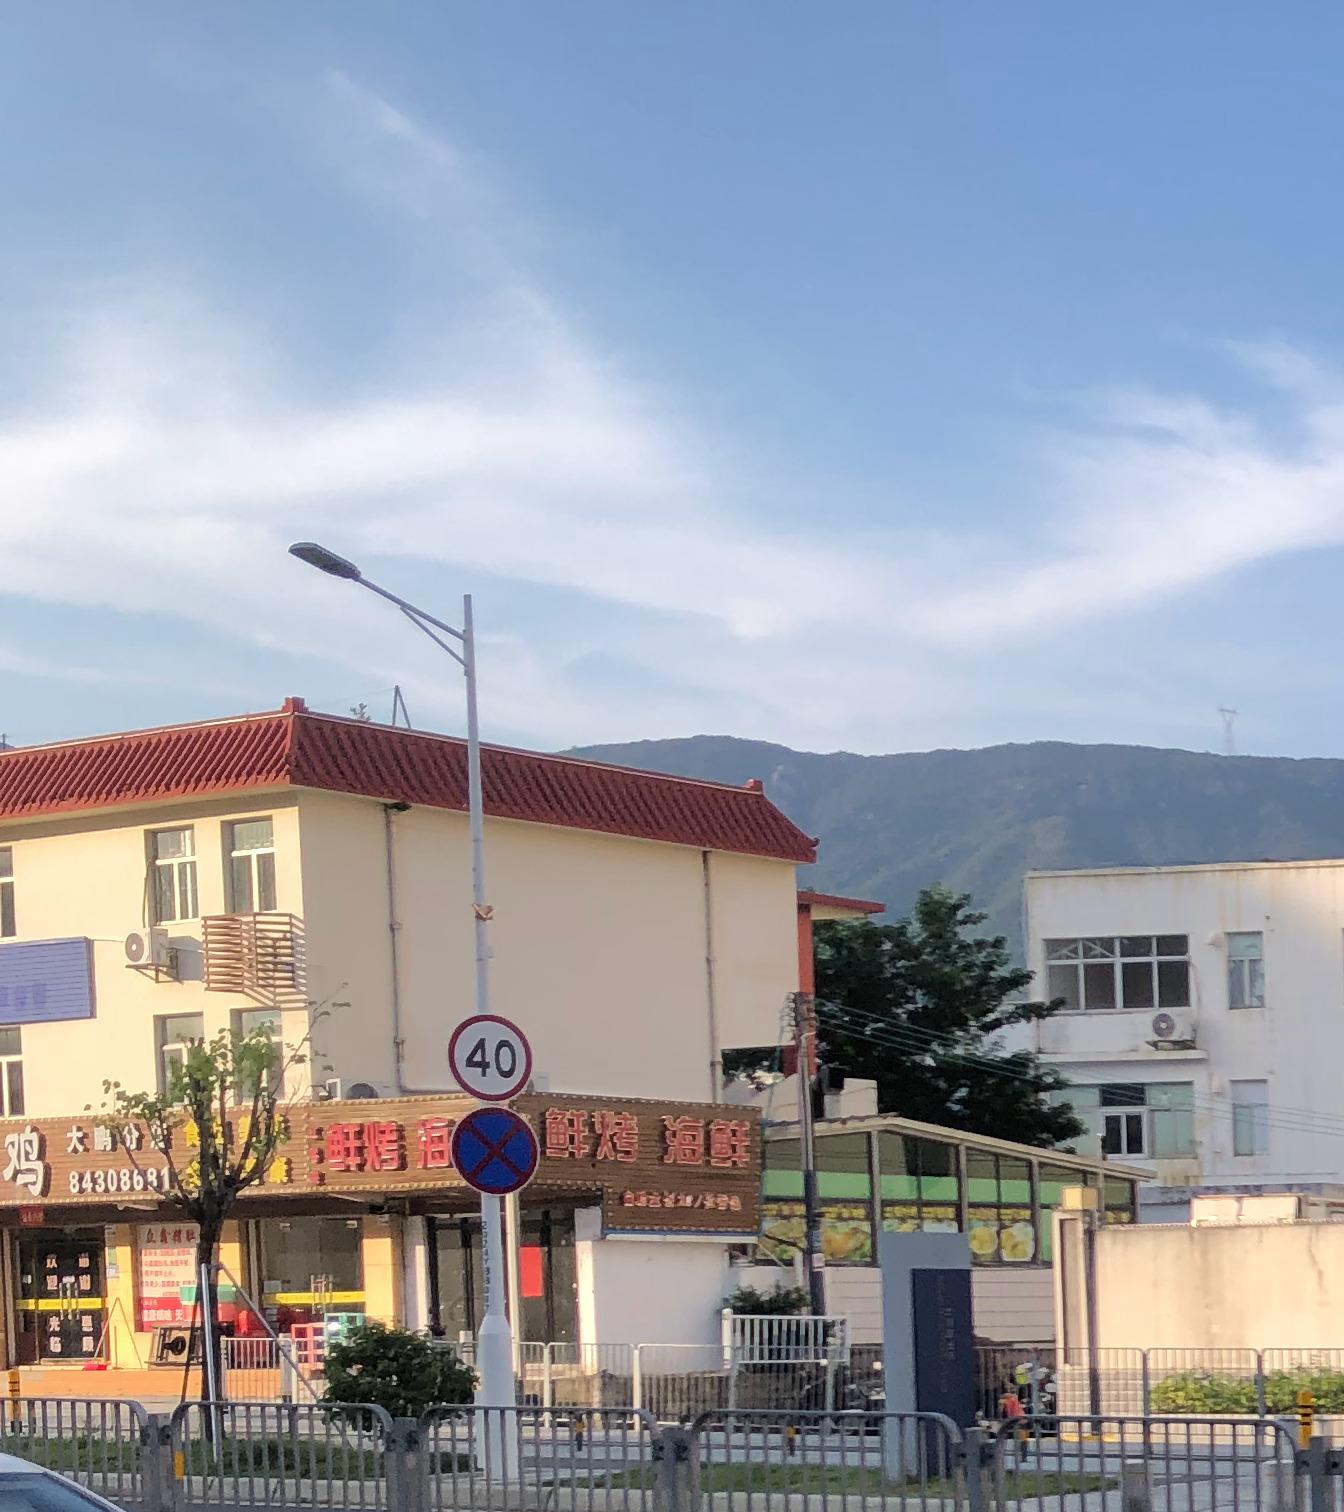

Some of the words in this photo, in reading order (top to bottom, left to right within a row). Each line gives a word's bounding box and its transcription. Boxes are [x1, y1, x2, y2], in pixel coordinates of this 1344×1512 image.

[465, 1037, 517, 1079] 40
[3, 1125, 44, 1197] 鸡
[545, 1107, 750, 1168] 鲜烤海鲜
[69, 1167, 171, 1194] 84308681
